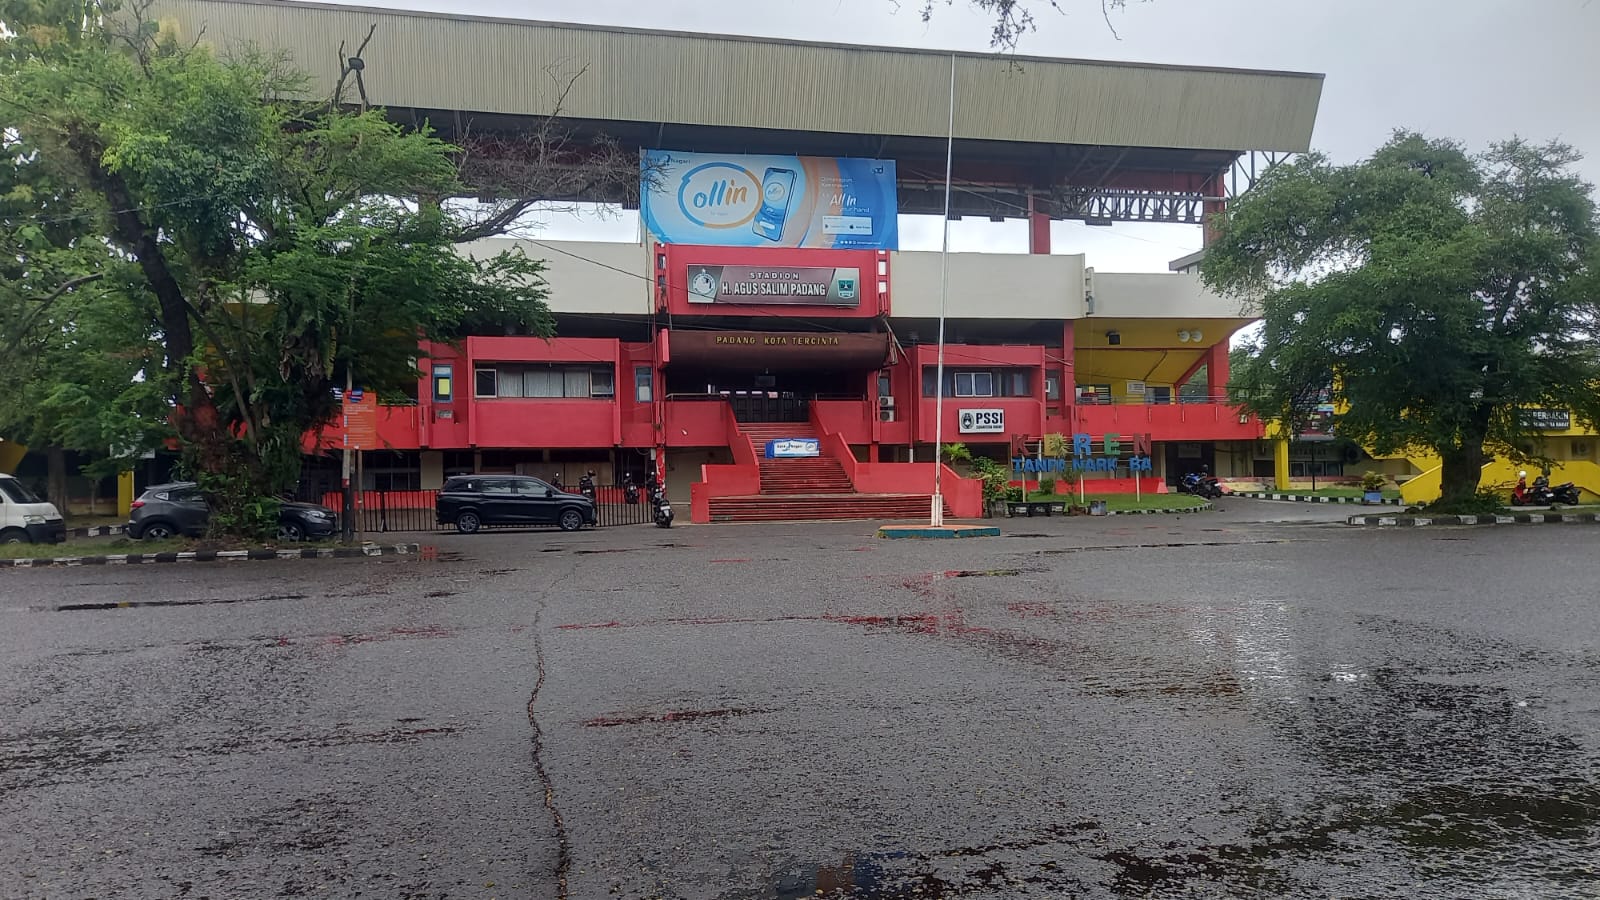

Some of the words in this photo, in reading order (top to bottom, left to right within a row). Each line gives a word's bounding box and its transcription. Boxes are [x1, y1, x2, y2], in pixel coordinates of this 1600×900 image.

[693, 179, 748, 208] ollin
[830, 193, 846, 207] All
[846, 194, 857, 207] In
[749, 272, 800, 280] STADION
[722, 282, 732, 295] H.
[734, 283, 758, 295] AGUS
[760, 283, 788, 296] SALIM
[790, 284, 826, 296] PADANG
[716, 336, 756, 344] PADANG
[764, 336, 787, 345] KOTA
[792, 337, 839, 345] TERCINTA
[976, 412, 1003, 424] PSSI
[1011, 433, 1152, 456] KEREN
